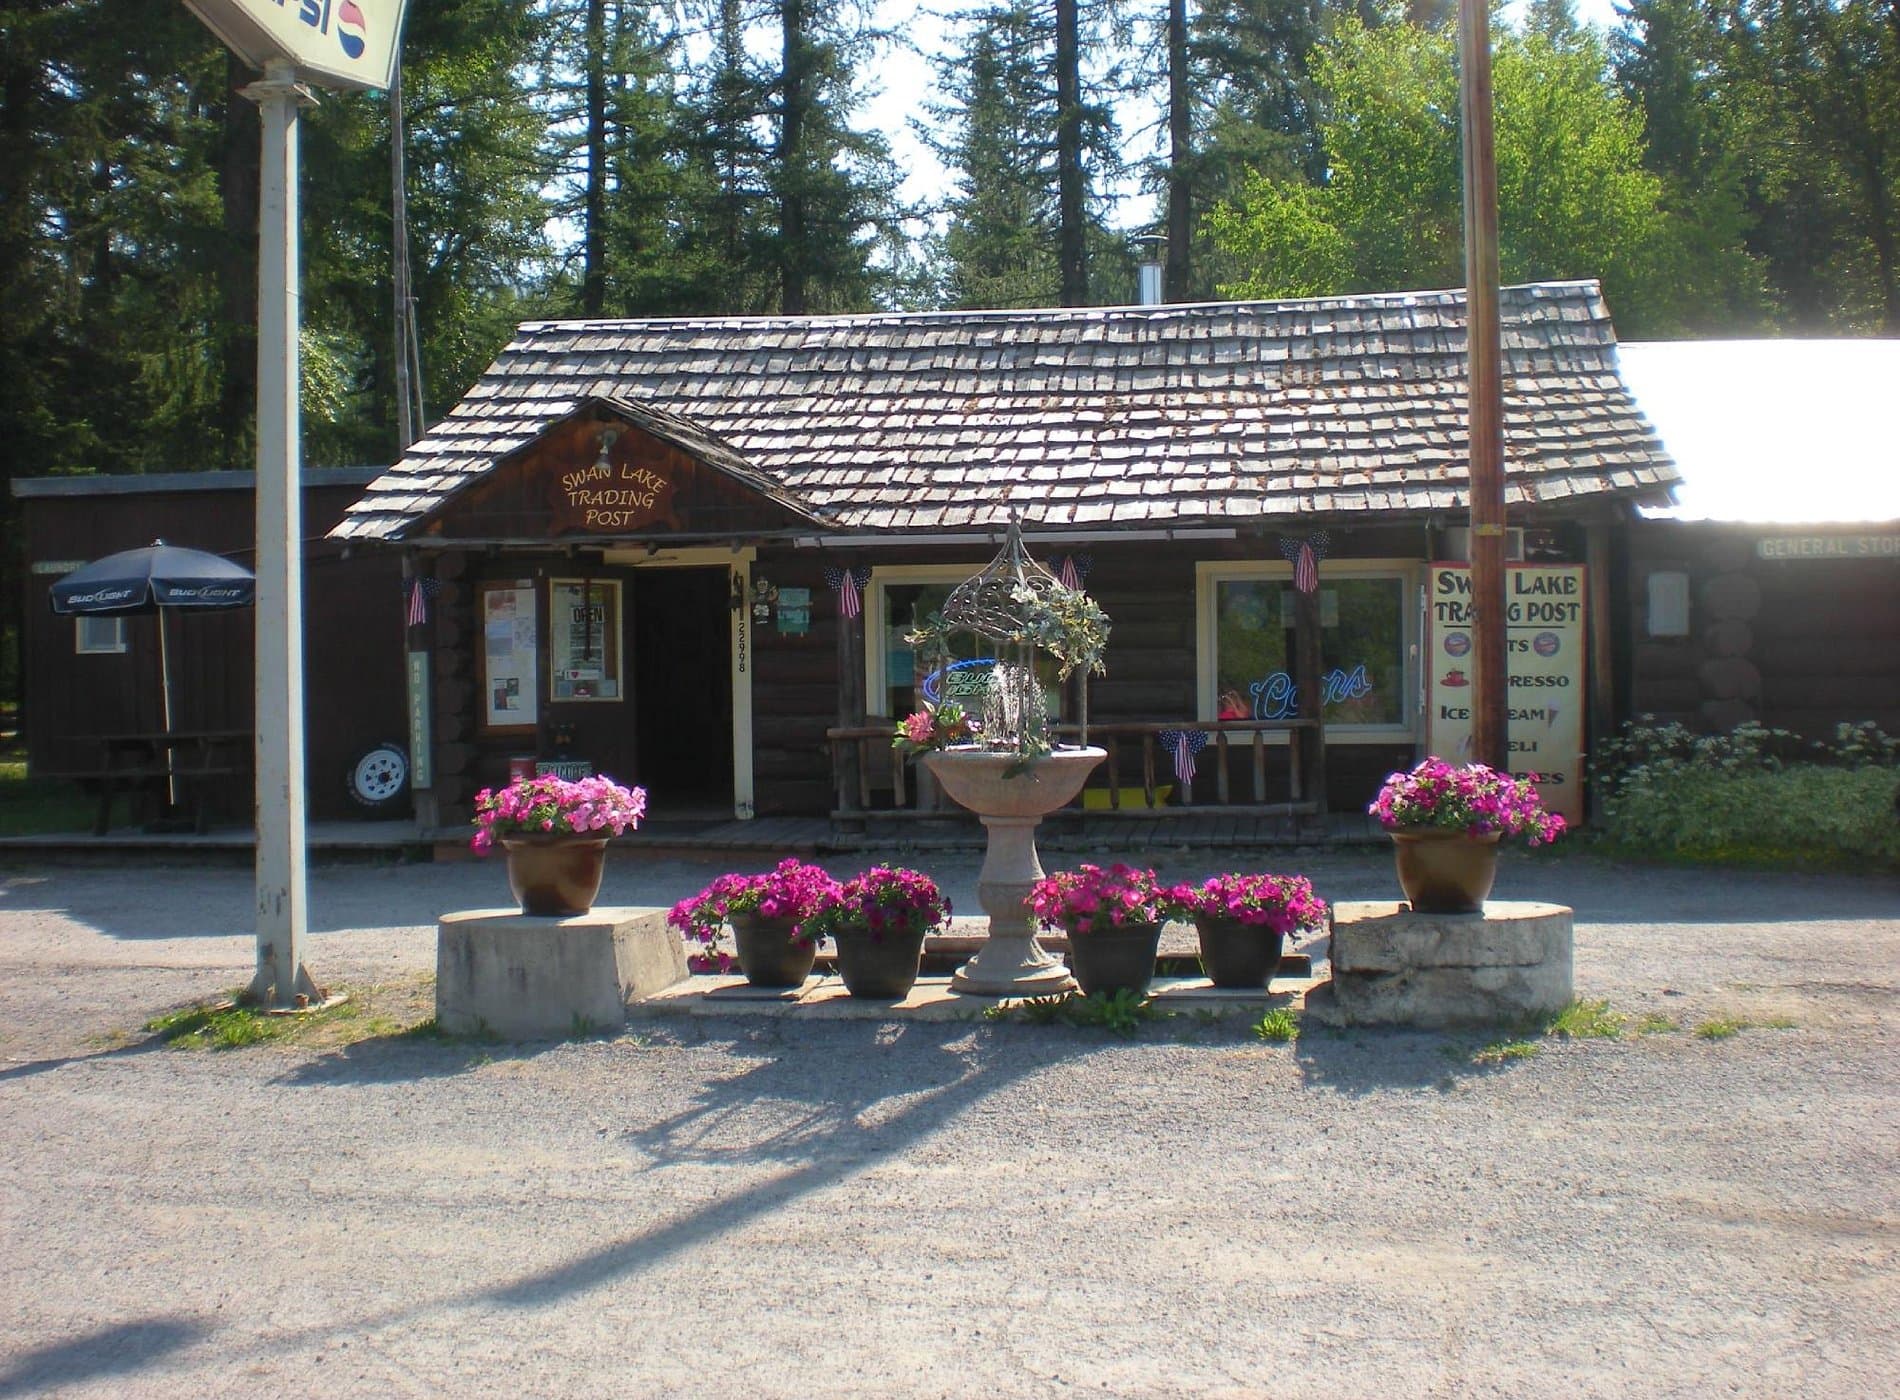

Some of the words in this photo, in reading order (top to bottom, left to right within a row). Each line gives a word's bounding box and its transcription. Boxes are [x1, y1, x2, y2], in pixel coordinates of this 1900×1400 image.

[562, 464, 611, 491] SWAN
[621, 463, 668, 493] LAKE
[568, 490, 655, 509] TRADING
[586, 509, 635, 526] POST
[1763, 537, 1849, 556] GENERAL
[1438, 571, 1473, 595] SW
[1515, 572, 1577, 595] LAKE
[67, 593, 93, 604] BUD
[100, 589, 132, 602] LIGHT
[169, 588, 196, 597] BUD
[202, 588, 241, 598] LIGHT
[1434, 601, 1521, 622] TRAG
[1527, 602, 1581, 622] POST
[413, 660, 421, 684] NO
[1509, 675, 1569, 688] RESSO
[1440, 705, 1470, 719] ICE
[1507, 708, 1545, 721] EAM
[414, 694, 424, 781] PARKING
[1507, 741, 1538, 752] ELI
